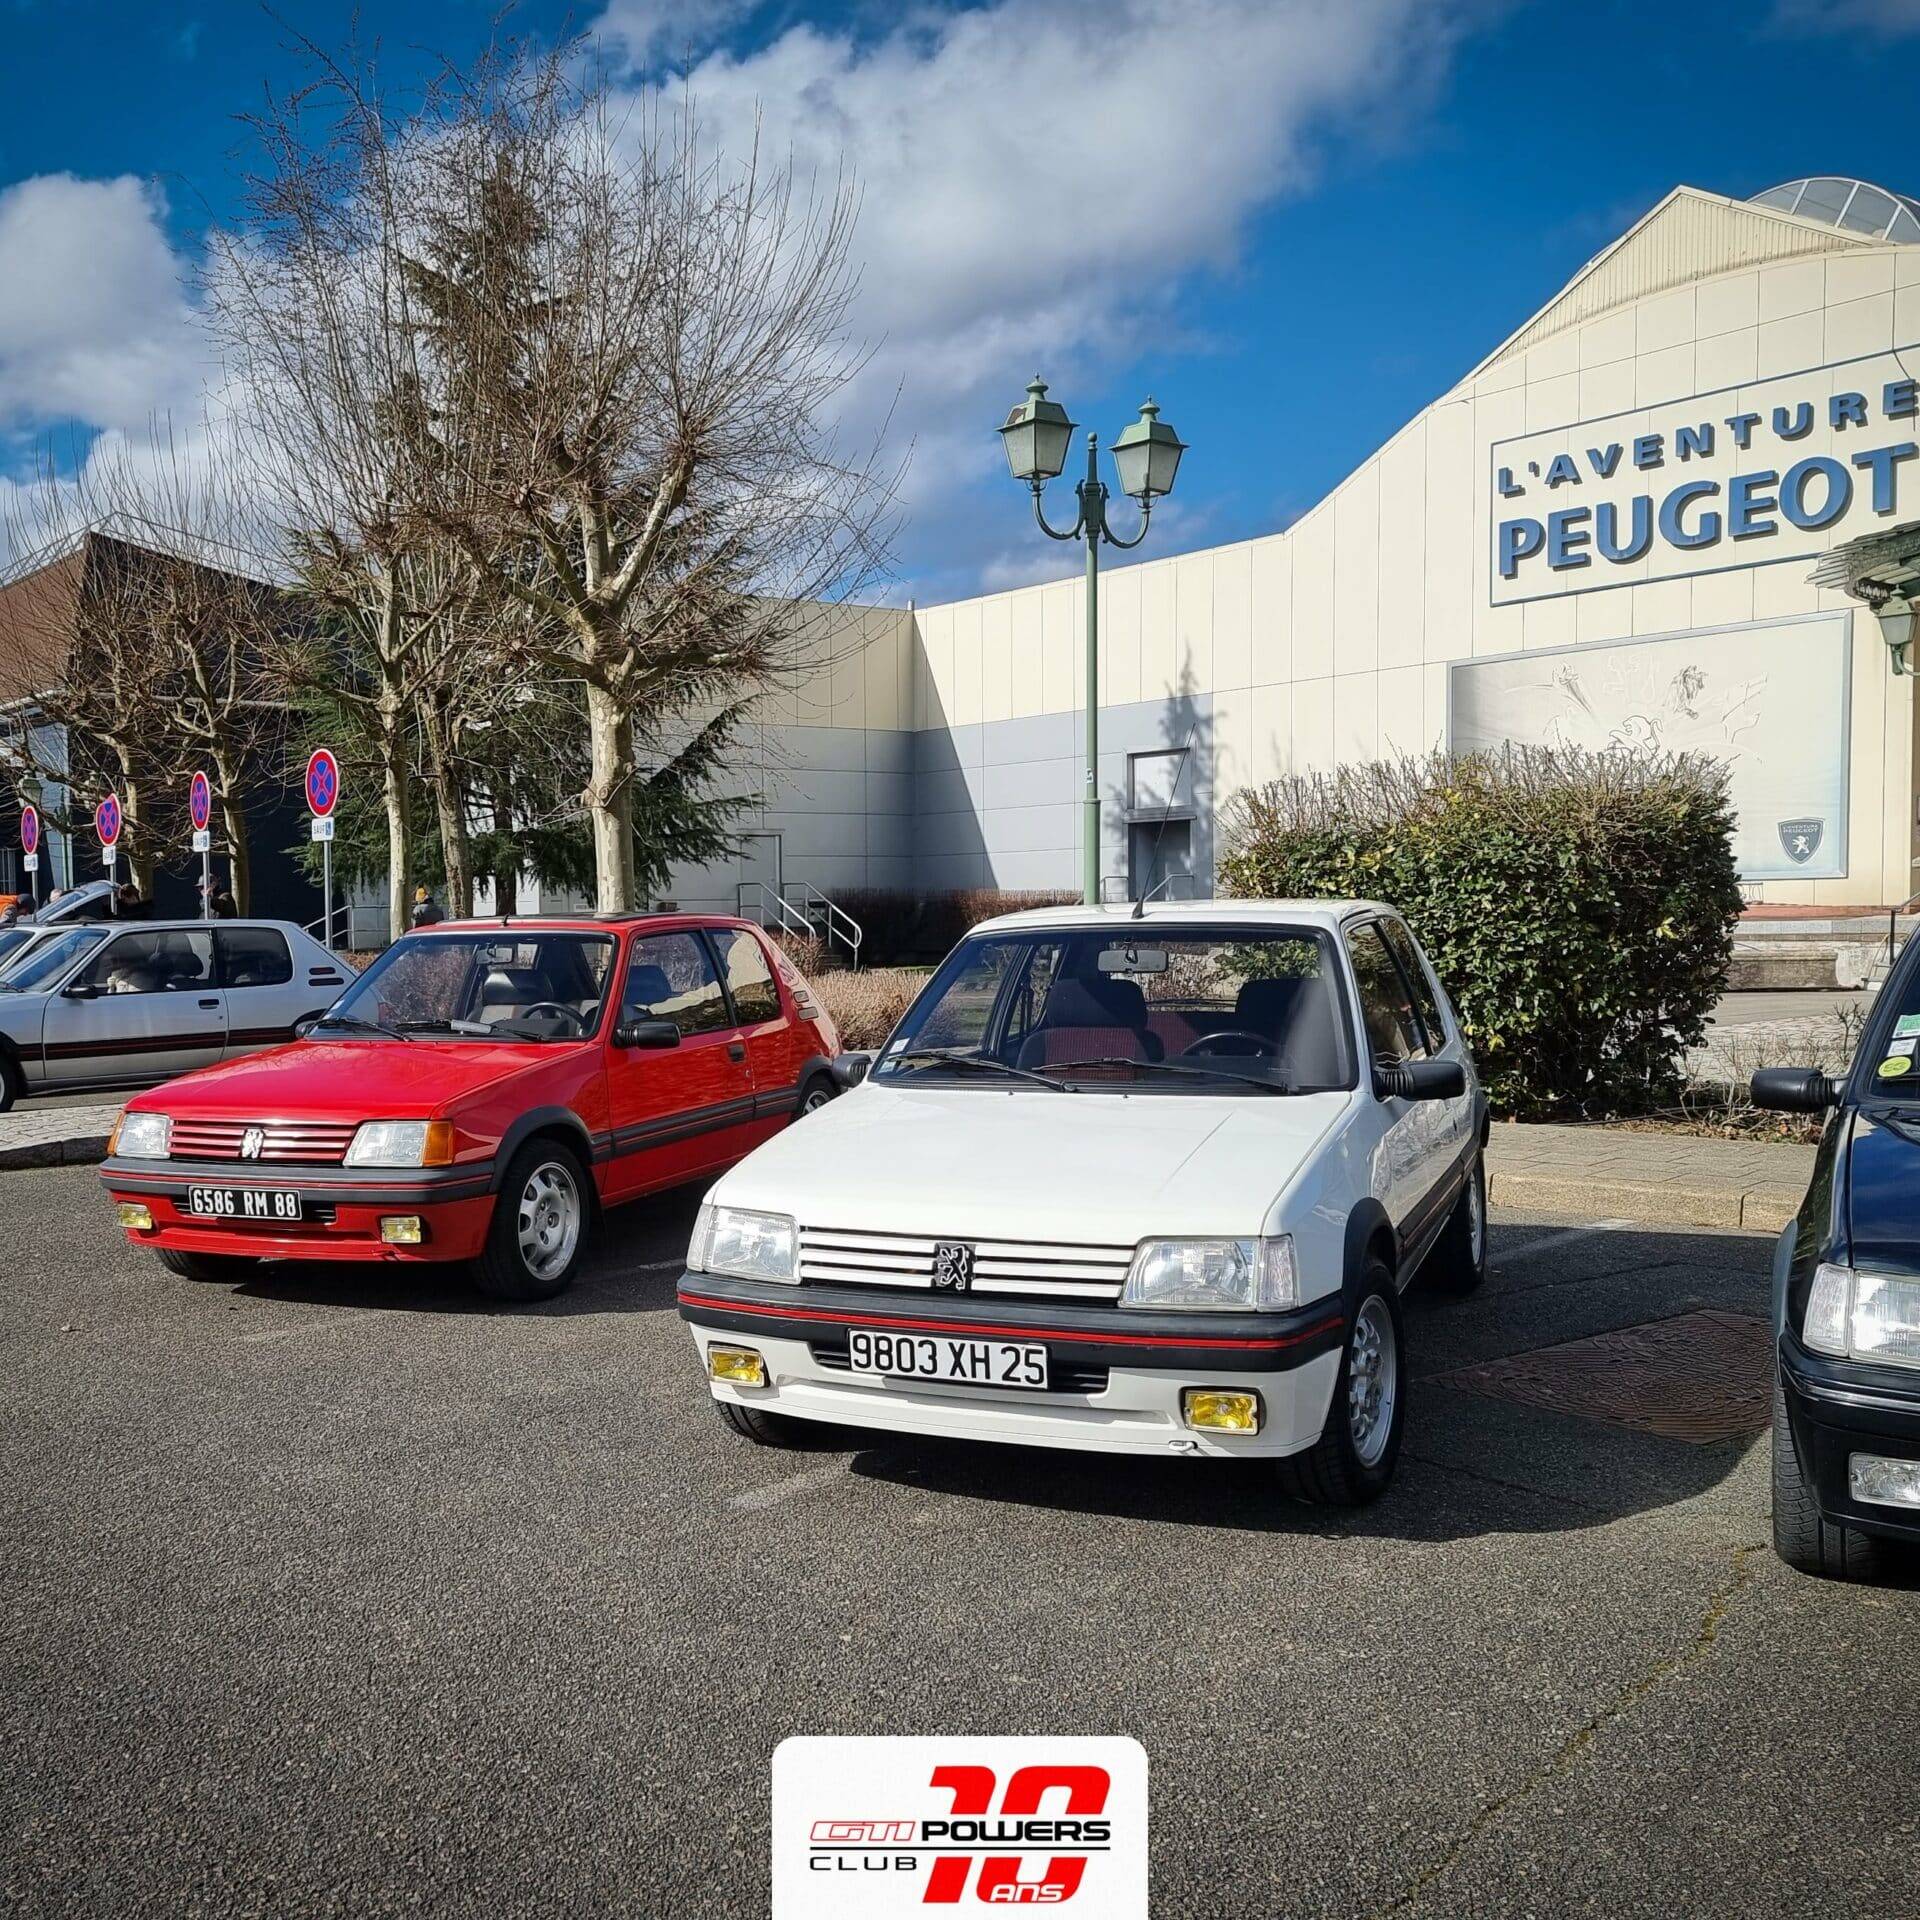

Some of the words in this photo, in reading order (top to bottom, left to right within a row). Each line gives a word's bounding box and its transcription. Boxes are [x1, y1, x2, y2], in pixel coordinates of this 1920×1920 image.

[1498, 379, 1918, 496] L'AVENTURE
[1499, 442, 1917, 577] PEUGEOT
[193, 1189, 235, 1214] 6586
[243, 1191, 268, 1216] RM
[274, 1193, 296, 1217] 88
[852, 1334, 938, 1375] 9803
[948, 1342, 990, 1379] XH
[1000, 1346, 1045, 1385] 25
